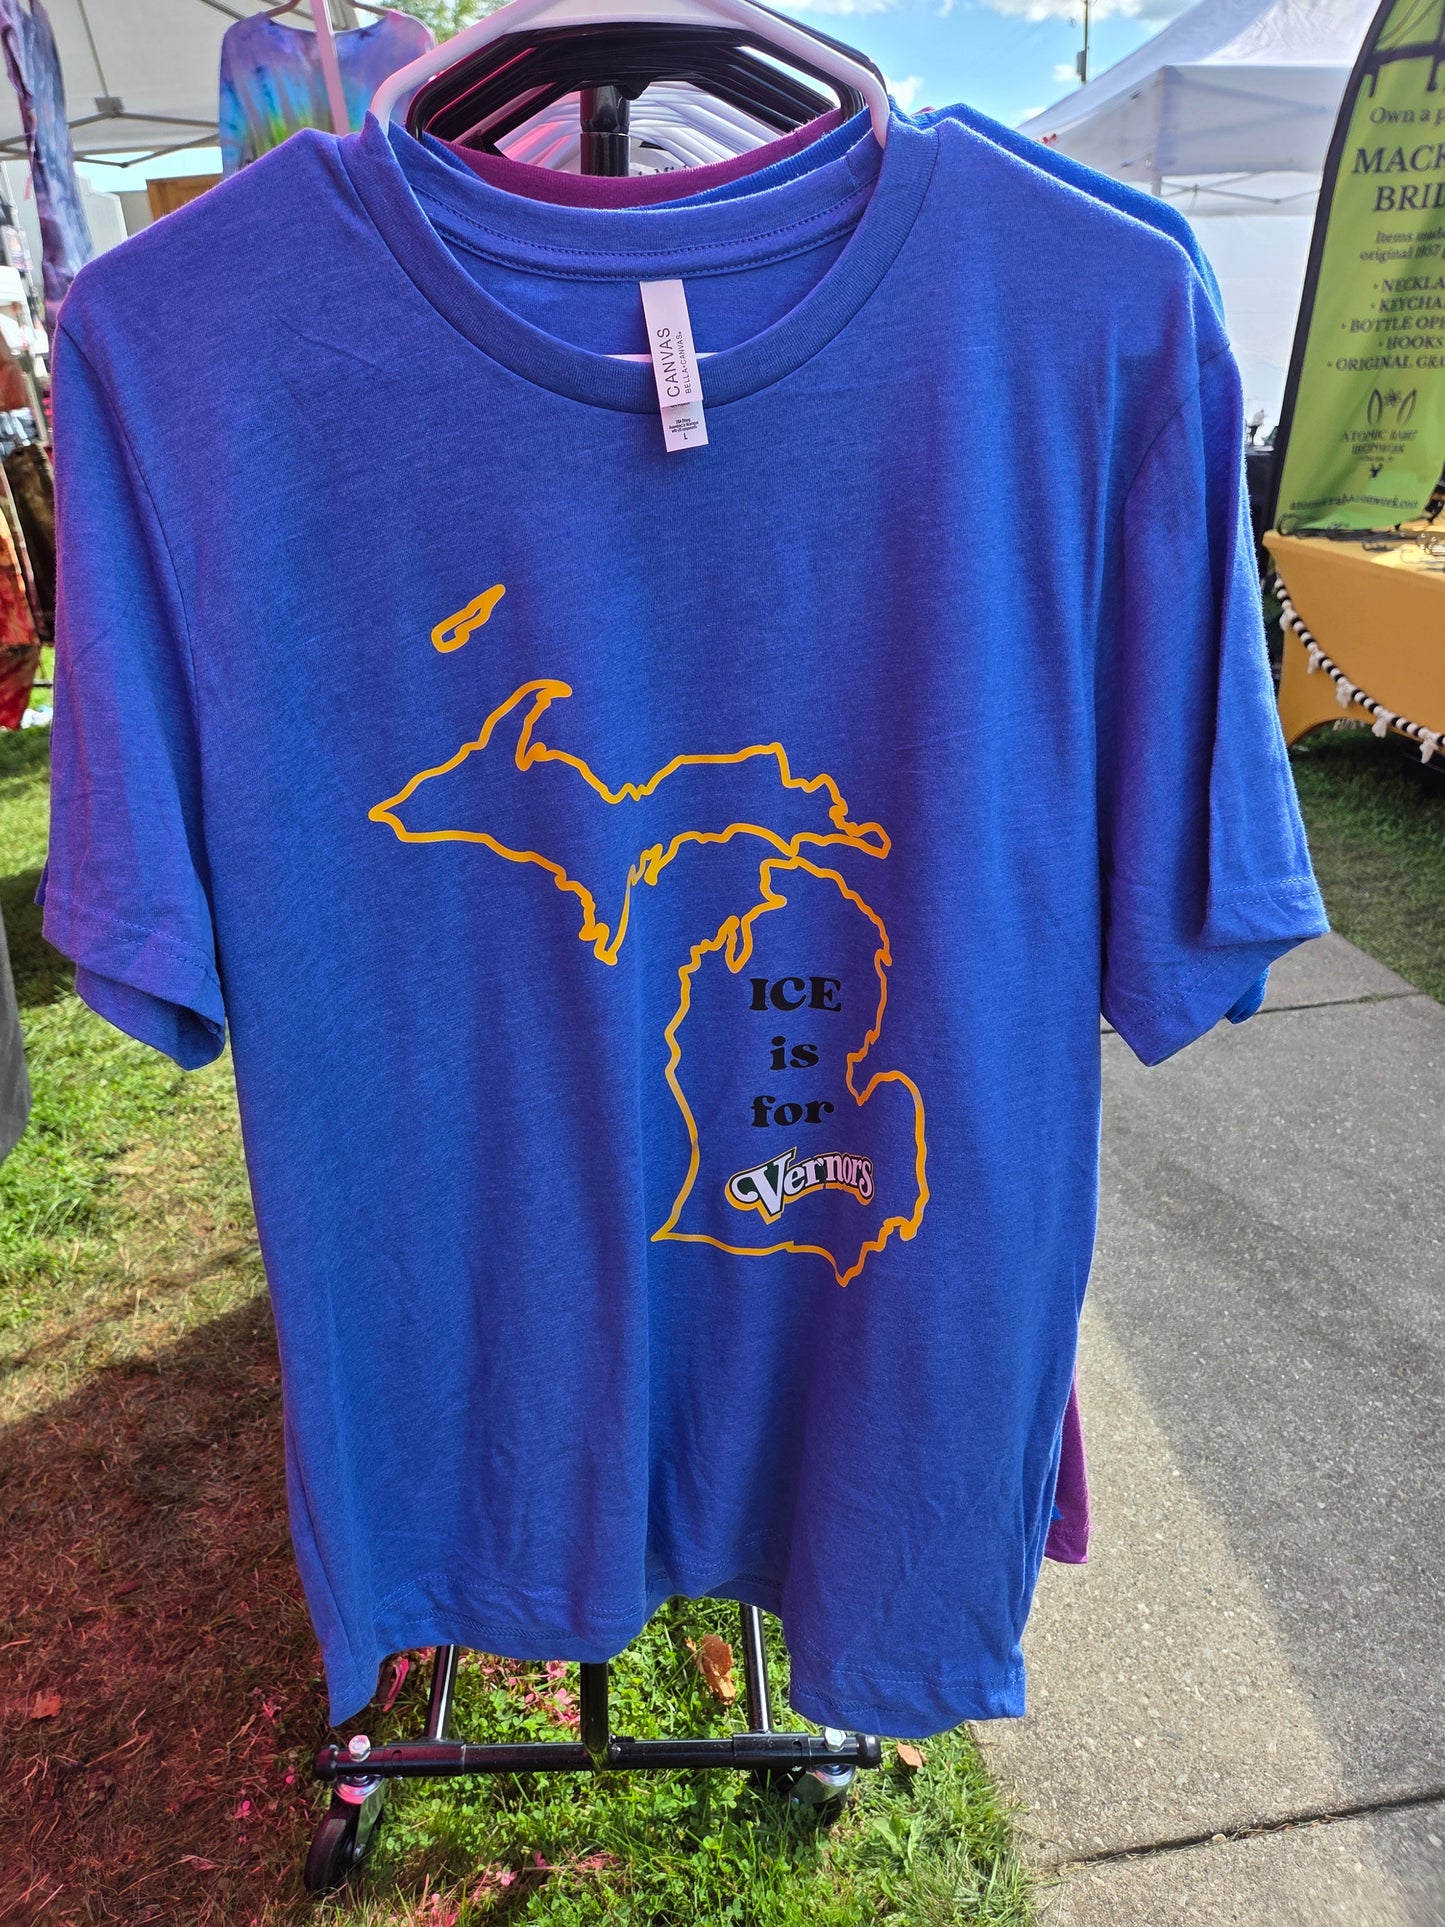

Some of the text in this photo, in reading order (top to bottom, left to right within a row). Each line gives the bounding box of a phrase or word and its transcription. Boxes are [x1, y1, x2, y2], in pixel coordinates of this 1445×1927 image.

[1370, 106, 1416, 125] Own
[1420, 108, 1431, 122] a
[1376, 230, 1413, 244] Items
[1360, 246, 1414, 264] original
[1350, 315, 1413, 333] BOTTLE
[1386, 335, 1443, 350] HOOKS
[656, 327, 681, 398] CANVAS
[1335, 355, 1413, 372] ORIGINAL
[749, 976, 842, 1012] ICE
[769, 1035, 820, 1071] is
[751, 1095, 835, 1128] for
[727, 1147, 874, 1220] Vernors
